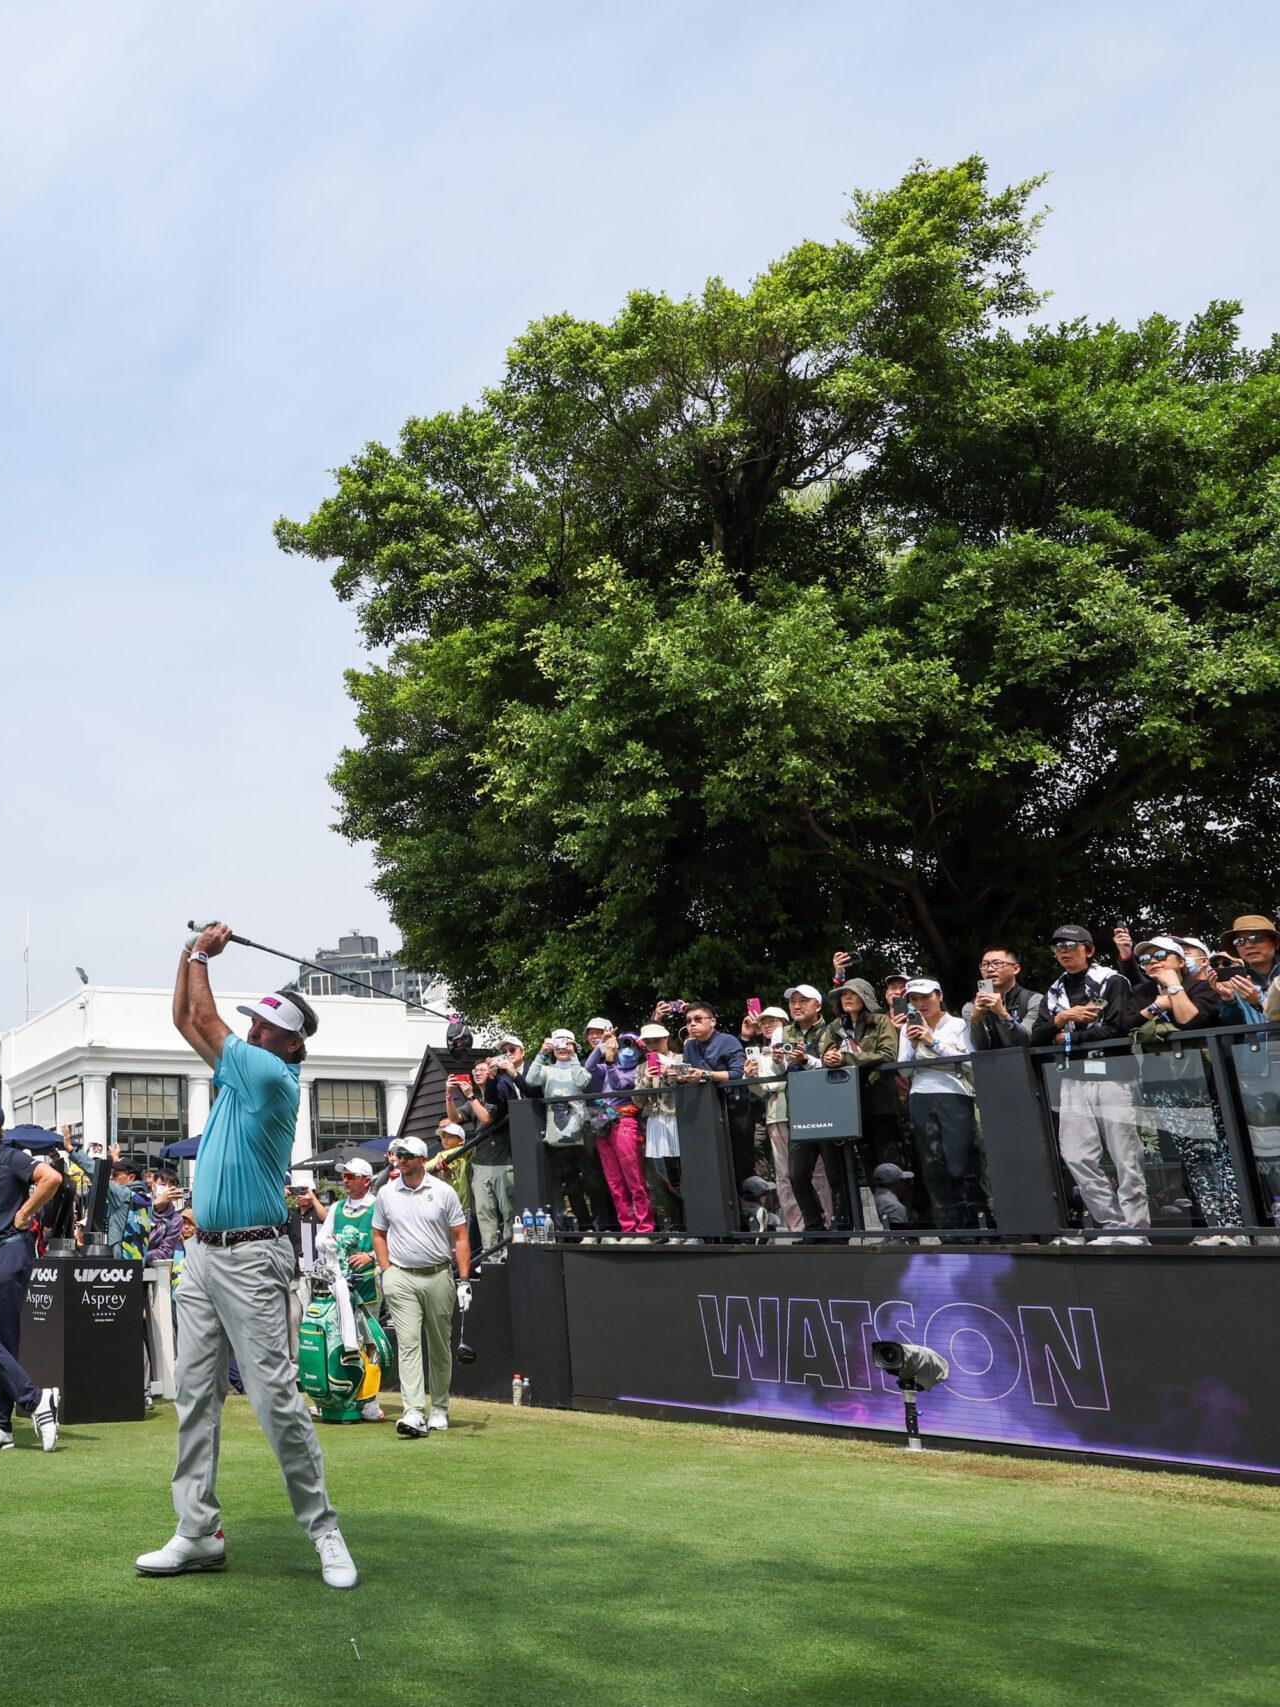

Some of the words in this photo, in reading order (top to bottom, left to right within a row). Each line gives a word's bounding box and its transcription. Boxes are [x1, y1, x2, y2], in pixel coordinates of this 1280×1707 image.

[793, 1122, 833, 1130] TRACKMAN
[26, 1288, 53, 1310] Asprey
[81, 1290, 127, 1310] Asprey
[697, 1294, 1110, 1411] WATSON
